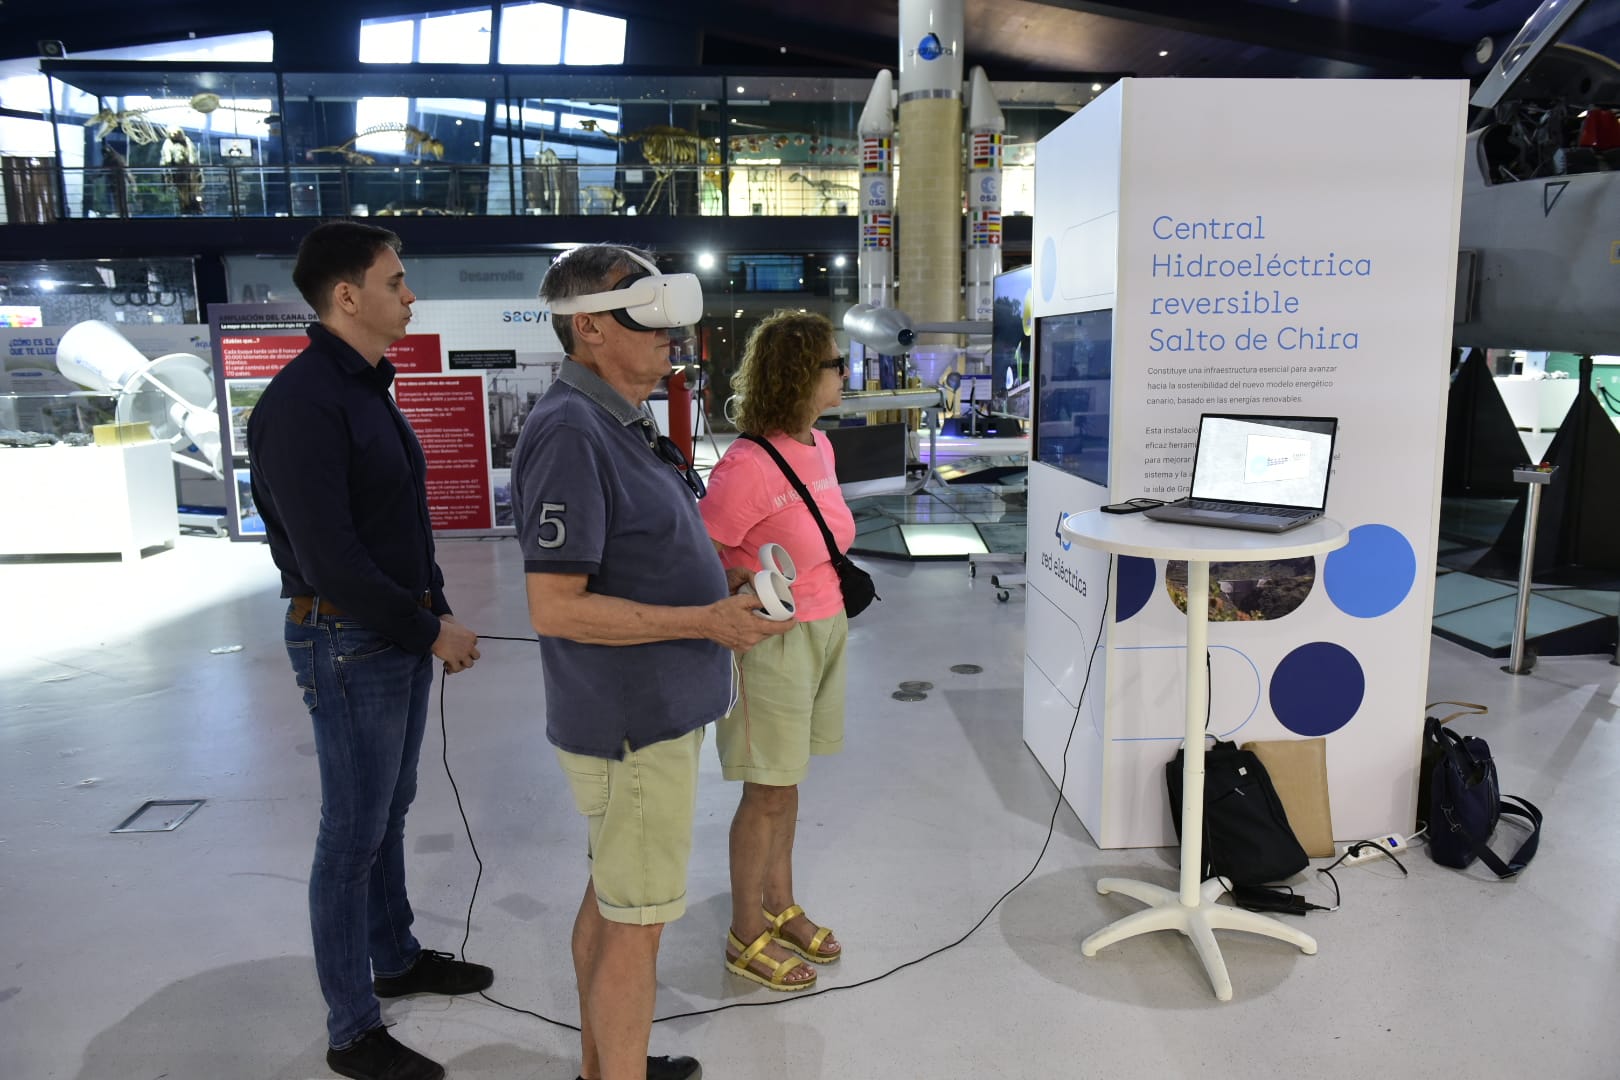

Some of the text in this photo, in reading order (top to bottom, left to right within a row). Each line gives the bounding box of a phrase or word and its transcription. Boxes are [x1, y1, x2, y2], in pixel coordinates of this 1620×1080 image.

[1152, 215, 1265, 240] Central
[1152, 252, 1371, 277] Hidroeléctrica
[1150, 290, 1299, 315] reversible
[502, 311, 549, 323] sacyr
[1149, 326, 1358, 352] Salto de Chira
[1147, 367, 1187, 376] Constituye
[1203, 366, 1258, 374] infraestructura
[1259, 365, 1289, 374] esencial
[1290, 366, 1307, 375] para
[1147, 382, 1167, 390] hacia
[1177, 381, 1228, 389] sostenibilidad
[1229, 381, 1241, 389] del
[1266, 380, 1294, 388] modelo
[1295, 379, 1334, 389] energético
[1146, 397, 1176, 406] canario,
[1177, 396, 1204, 404] basado
[1216, 396, 1228, 404] las
[1229, 395, 1260, 405] energías
[1261, 395, 1303, 404] renovables.
[1145, 426, 1199, 435] Esta instalació
[1168, 441, 1197, 449] herrami
[1144, 457, 1161, 465] para
[1162, 456, 1192, 465] mejorar
[1152, 485, 1165, 493] isla
[1166, 485, 1176, 493] de
[538, 502, 566, 549] 5
[1041, 552, 1087, 598] red eléctrica
